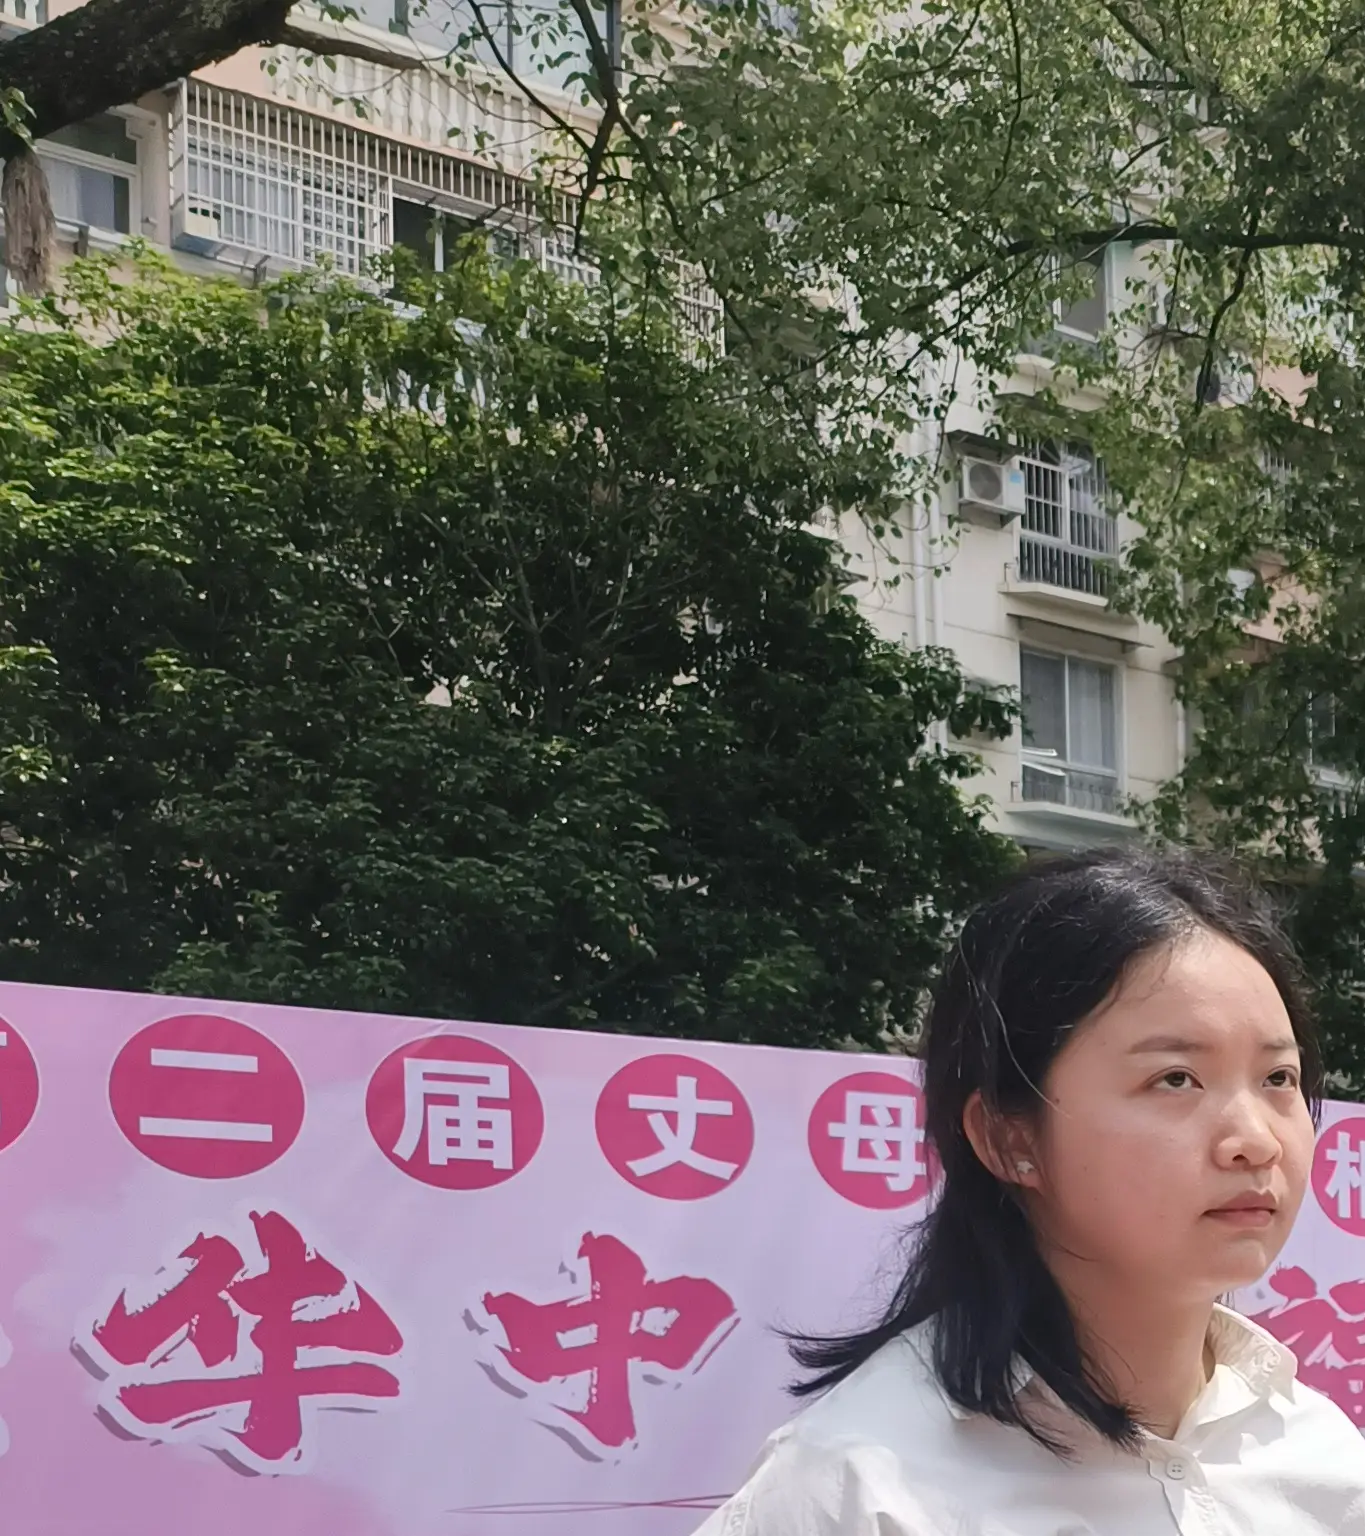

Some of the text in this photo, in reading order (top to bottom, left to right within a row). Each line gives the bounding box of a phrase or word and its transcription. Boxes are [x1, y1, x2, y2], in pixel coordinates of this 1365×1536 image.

[0, 1032, 928, 1192] 二届丈母
[93, 1210, 739, 1463] 华中
